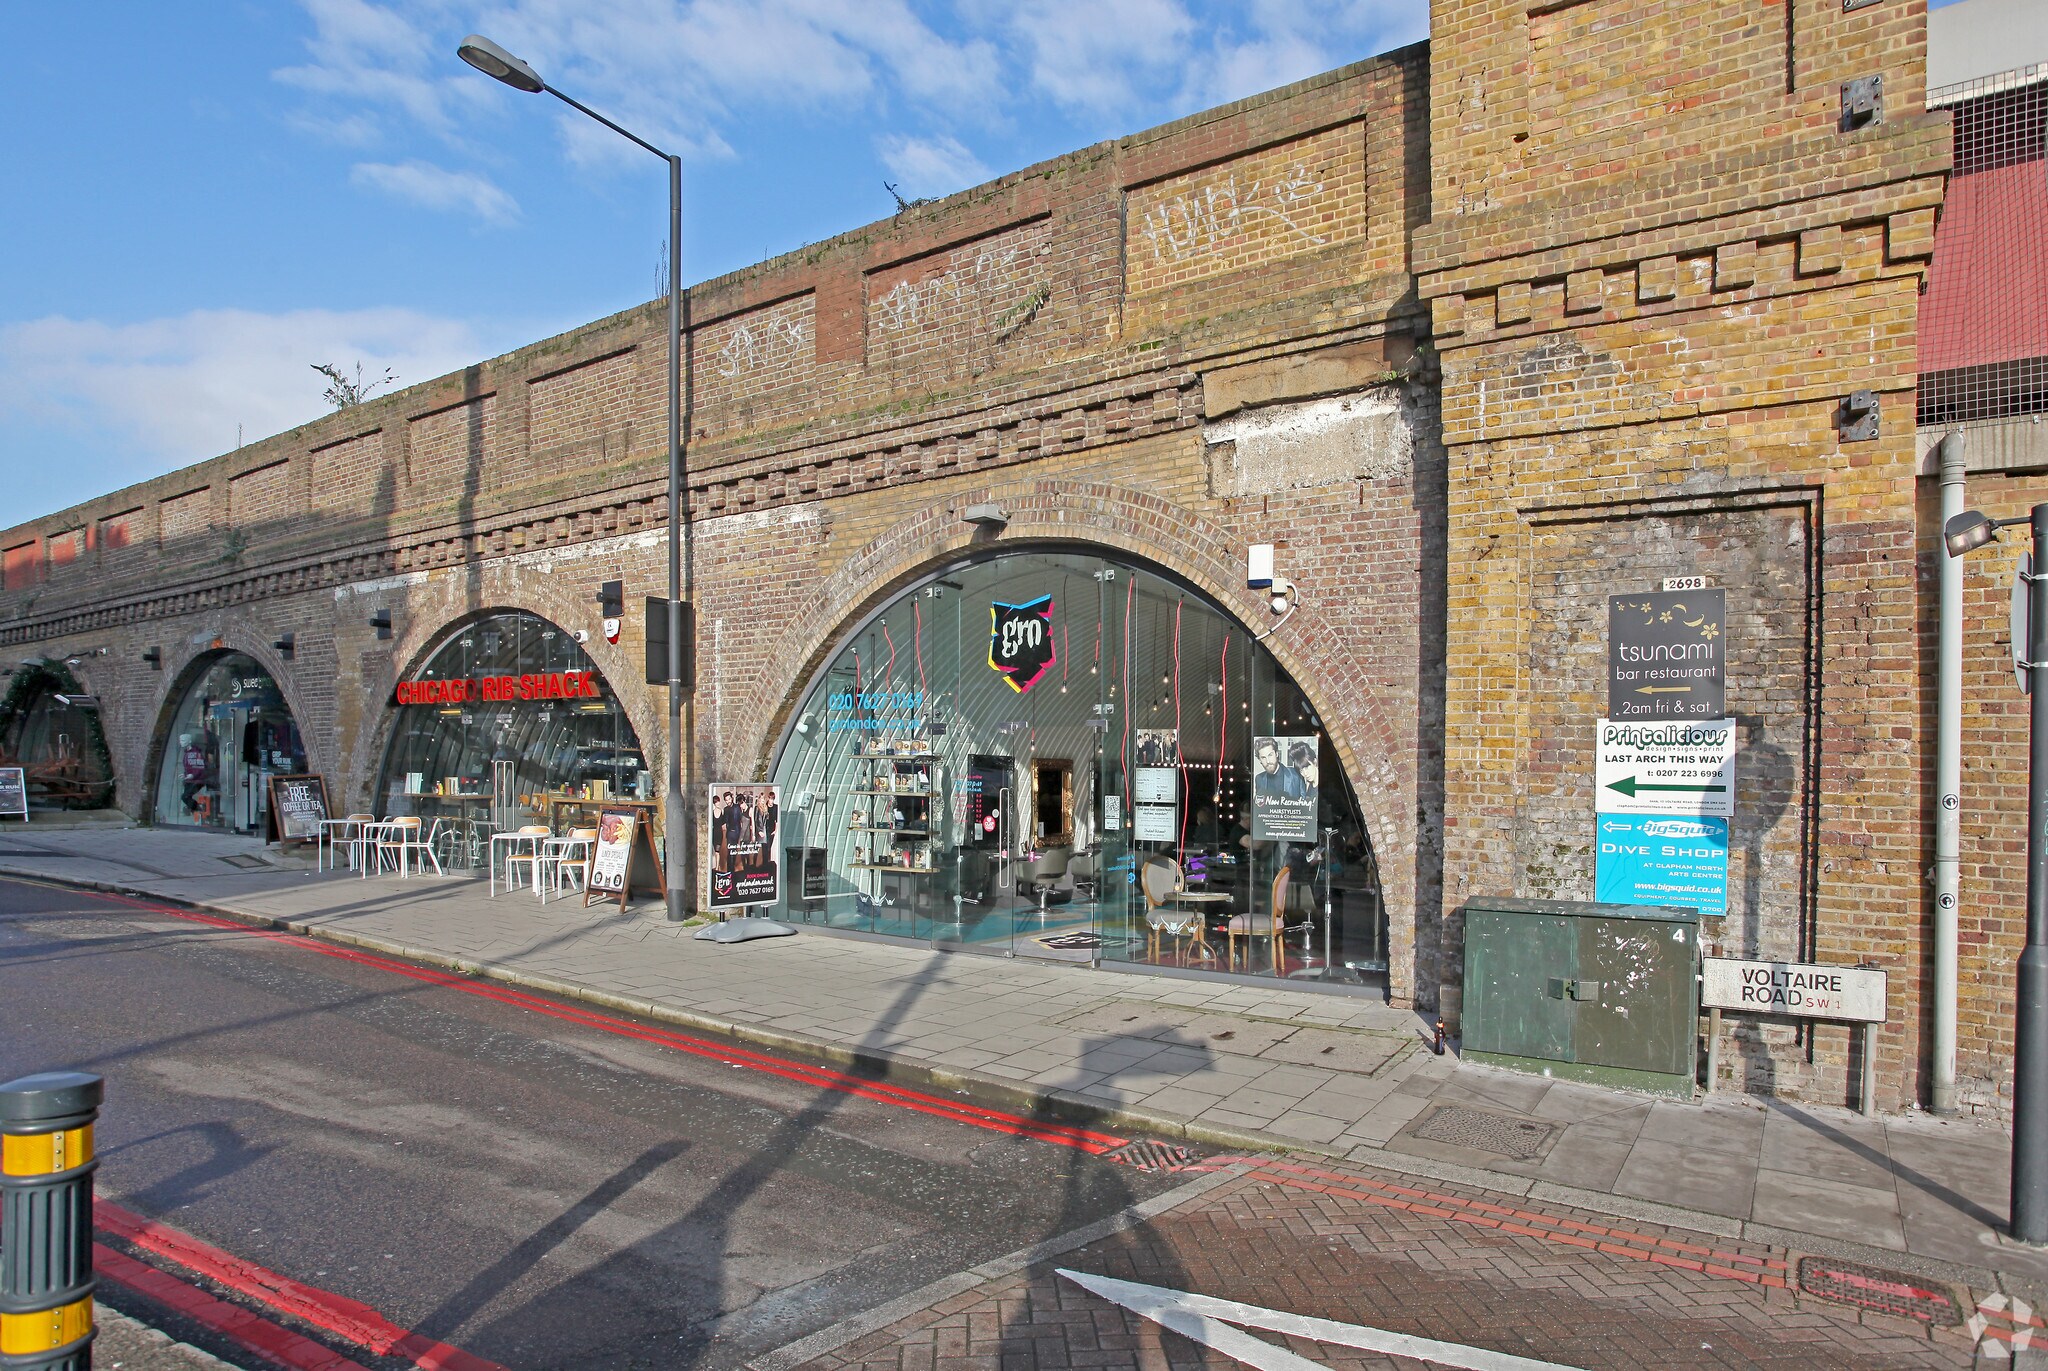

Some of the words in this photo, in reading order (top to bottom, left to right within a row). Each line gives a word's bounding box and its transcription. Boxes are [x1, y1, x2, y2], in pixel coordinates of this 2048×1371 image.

[1669, 578, 1701, 589] 2698
[1001, 616, 1042, 658] gro
[1619, 642, 1713, 661] tsunami
[1616, 665, 1640, 680] bar
[1644, 665, 1716, 679] restaurant
[397, 678, 477, 705] CHICAGO
[482, 675, 514, 702] RIB
[519, 671, 595, 700] SHACK
[828, 693, 853, 710] 020
[856, 693, 888, 710] 7627
[891, 691, 923, 710] 0169
[1622, 701, 1651, 715] 2am
[1656, 699, 1670, 713] fri
[1673, 700, 1685, 713] &
[1689, 701, 1711, 713] sat
[1603, 725, 1728, 751] Printalicious
[1605, 755, 1632, 763] LAST
[1635, 755, 1666, 763] ARCH
[1669, 755, 1695, 763] THIS
[1699, 756, 1724, 764] WAY
[1700, 770, 1723, 778] 6996
[289, 786, 311, 801] FREE
[283, 802, 302, 812] COFFEE
[310, 800, 322, 810] TEA
[1265, 795, 1280, 806] Now
[1280, 796, 1317, 811] Recruiting!
[1634, 882, 1723, 894] www.bigsquid.co.uk
[1672, 928, 1685, 943] 4
[1742, 968, 1842, 992] VOLTAIRE
[1742, 985, 1802, 1006] ROAD
